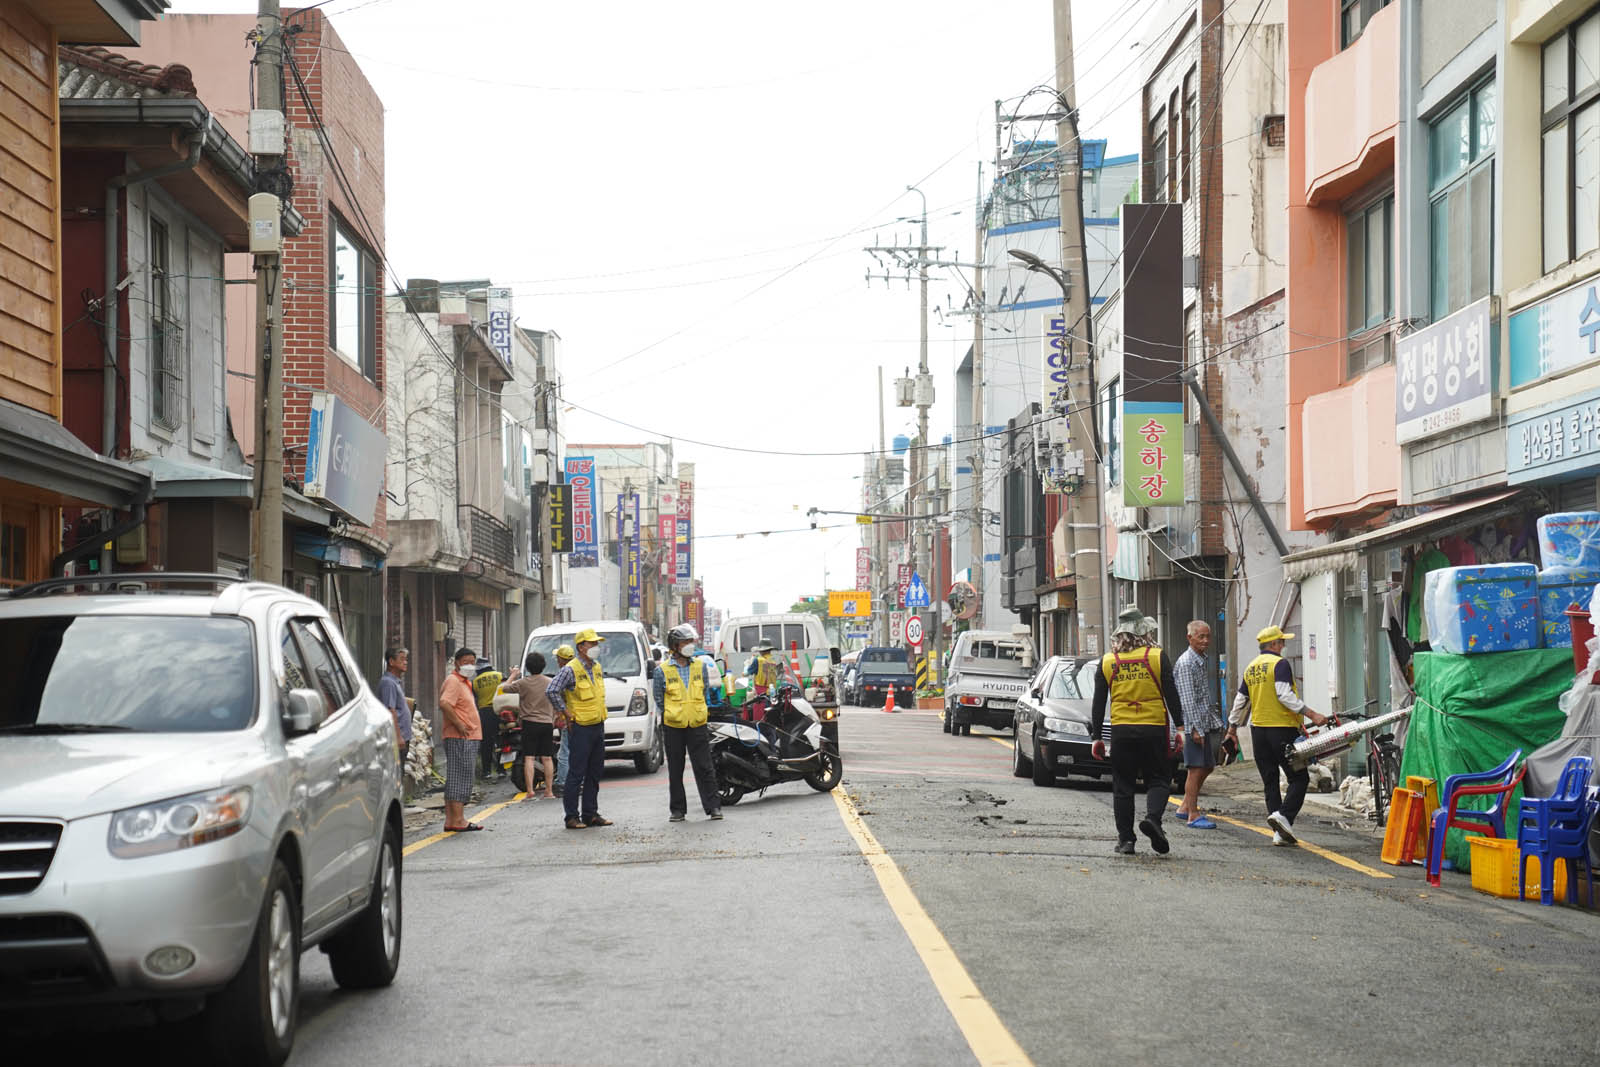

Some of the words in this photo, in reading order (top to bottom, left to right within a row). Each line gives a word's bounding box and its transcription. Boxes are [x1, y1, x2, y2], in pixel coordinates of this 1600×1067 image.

[1401, 313, 1484, 412] 정명상회
[567, 460, 592, 474] 대광
[1138, 419, 1167, 499] 송하장
[1523, 417, 1564, 466] 업소용품
[571, 476, 593, 544] 오토바이
[909, 624, 921, 638] 30
